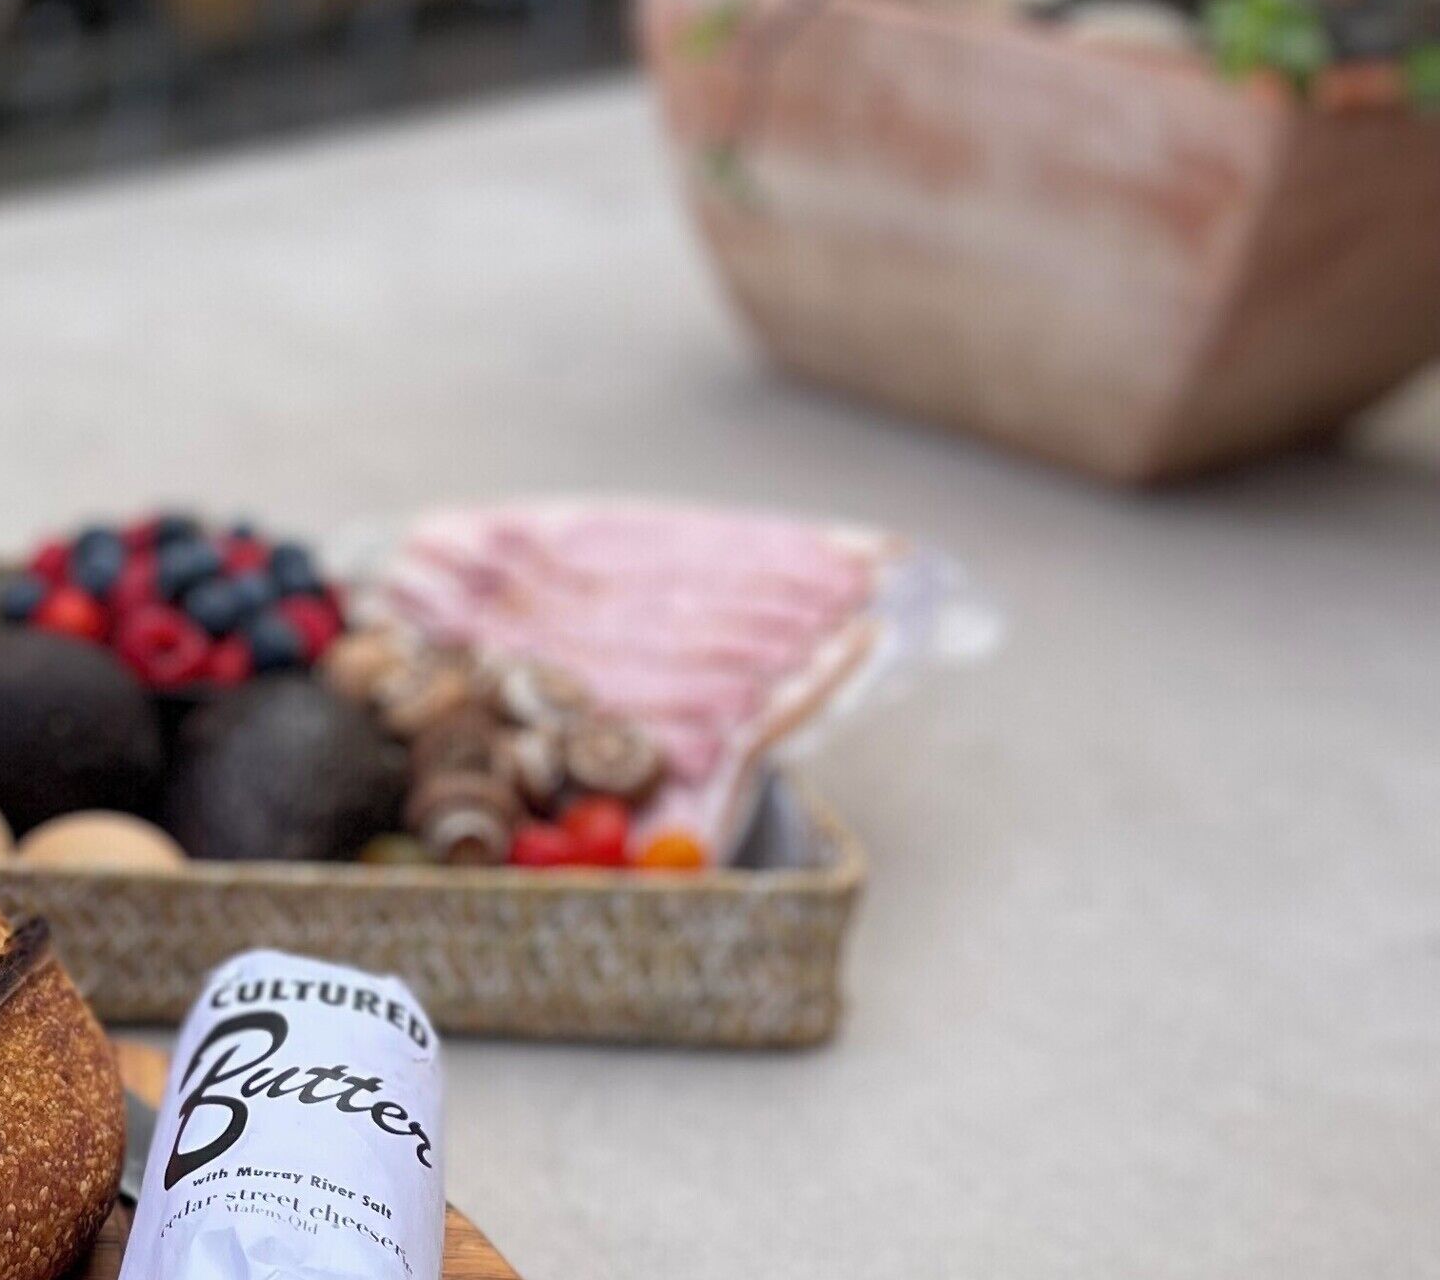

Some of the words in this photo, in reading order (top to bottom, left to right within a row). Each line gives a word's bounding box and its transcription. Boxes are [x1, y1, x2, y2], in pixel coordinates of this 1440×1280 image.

[211, 979, 429, 1051] CULTURED
[163, 1010, 433, 1192] Butter
[192, 1168, 229, 1187] with
[236, 1166, 304, 1185] Murray
[309, 1174, 357, 1200] River
[361, 1194, 393, 1220] Salt
[224, 1188, 302, 1213] street
